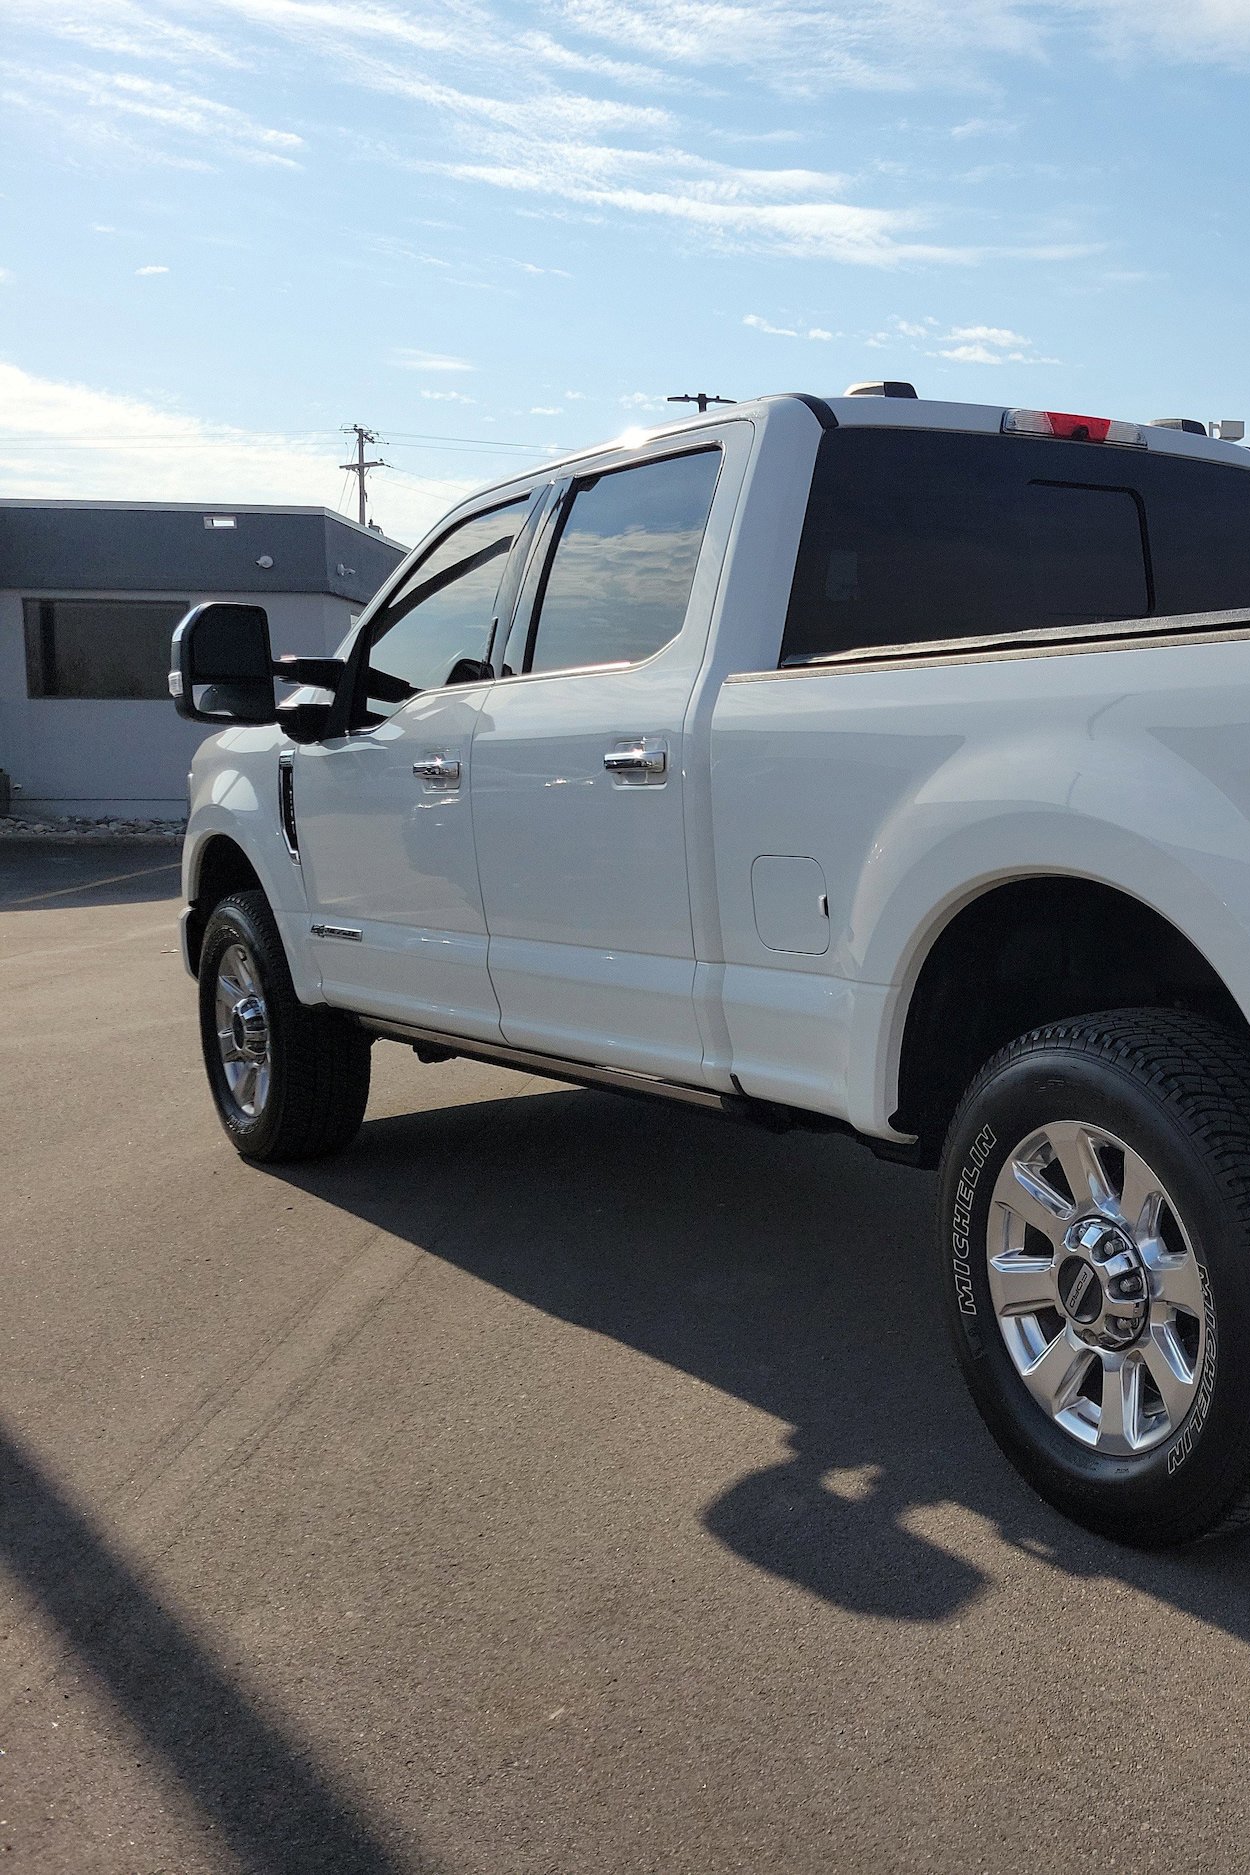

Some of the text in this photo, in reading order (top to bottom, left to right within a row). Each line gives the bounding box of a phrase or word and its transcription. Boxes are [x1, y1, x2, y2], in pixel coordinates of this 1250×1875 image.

[953, 1124, 998, 1316] MICHELIN
[1069, 1271, 1088, 1308] FORD
[1168, 1263, 1216, 1474] MICHELIN
